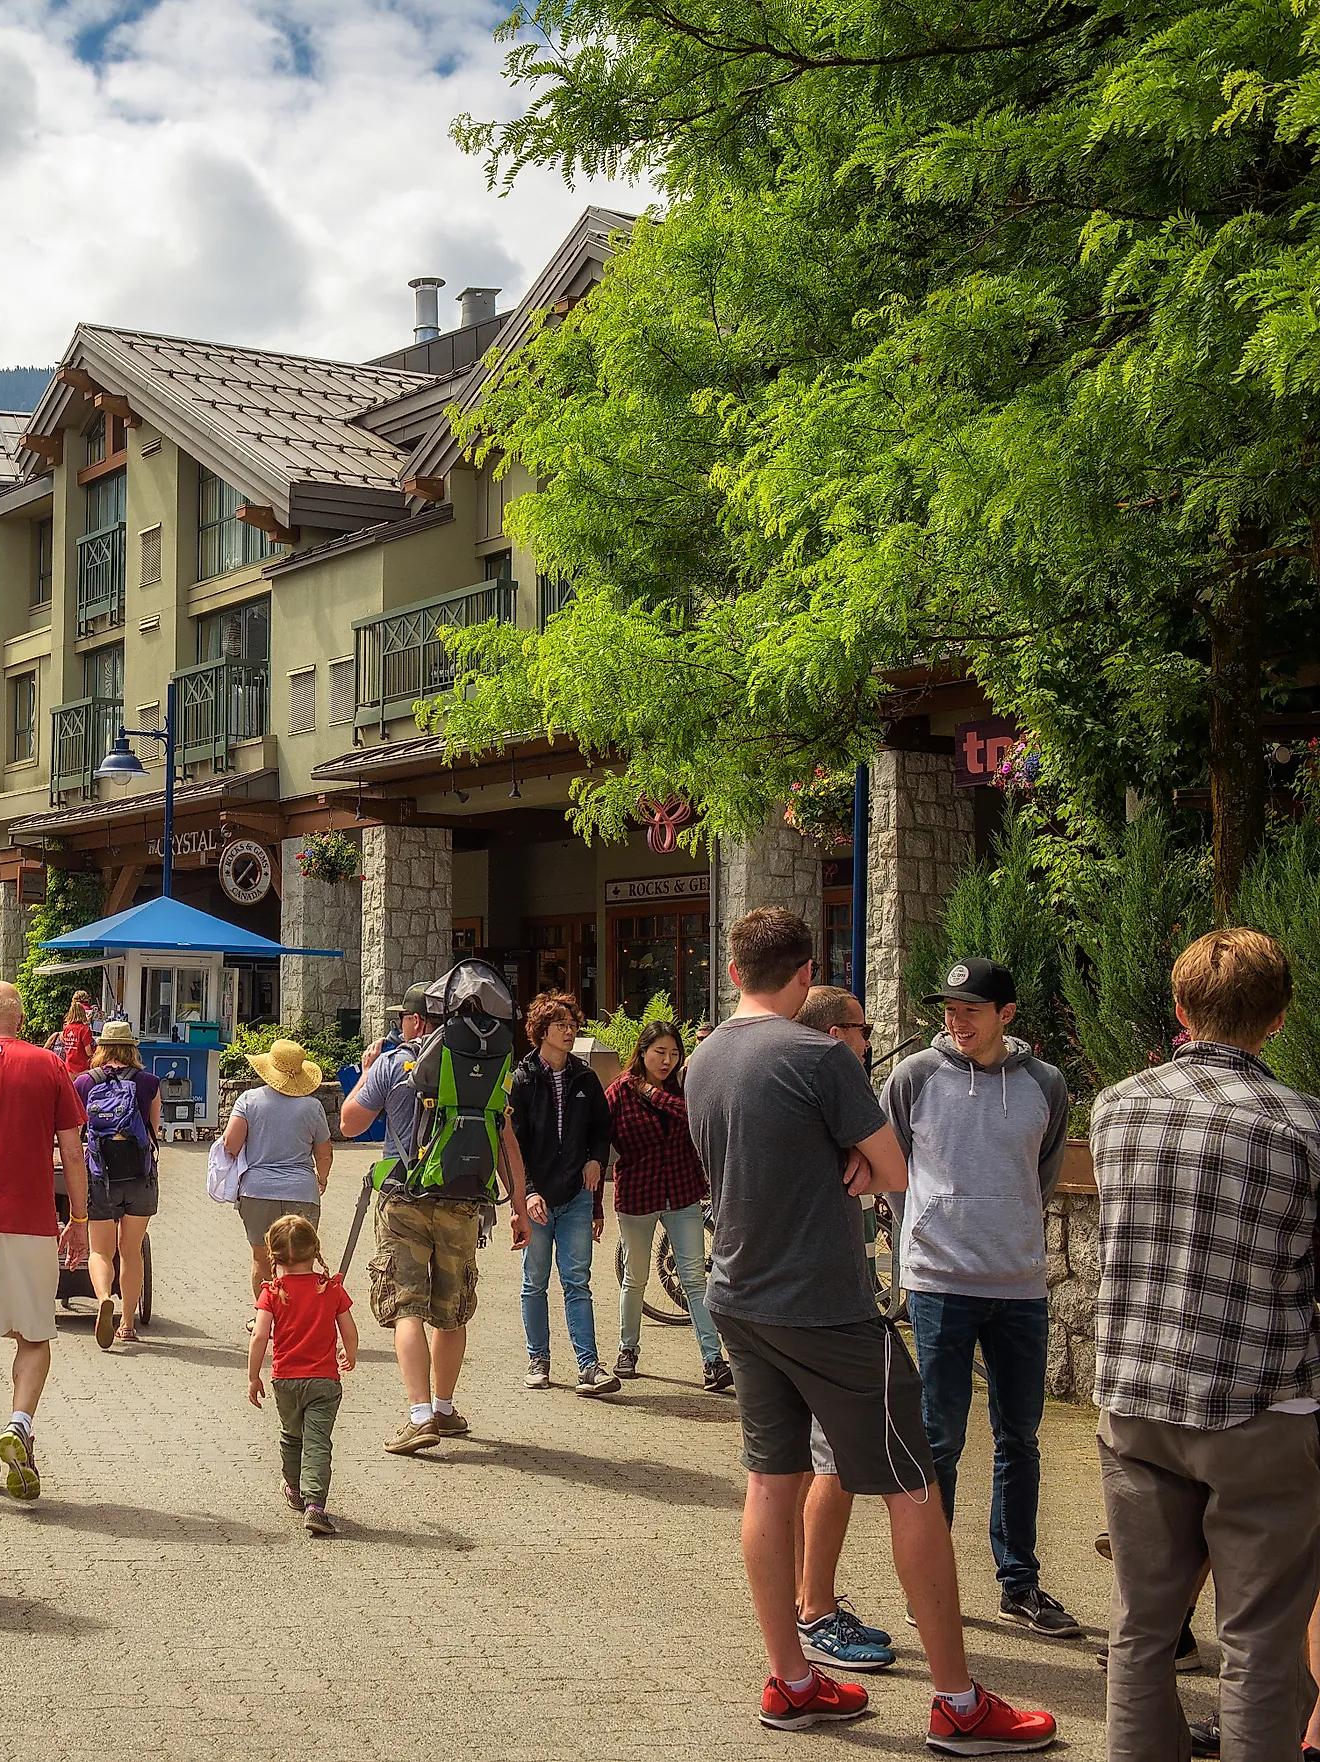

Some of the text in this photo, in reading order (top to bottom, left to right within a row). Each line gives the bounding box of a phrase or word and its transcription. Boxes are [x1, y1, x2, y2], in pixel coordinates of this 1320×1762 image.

[225, 842, 270, 869] ROCKS & GEMS
[229, 886, 264, 901] CANADA
[628, 877, 711, 897] ROCKS & GE
